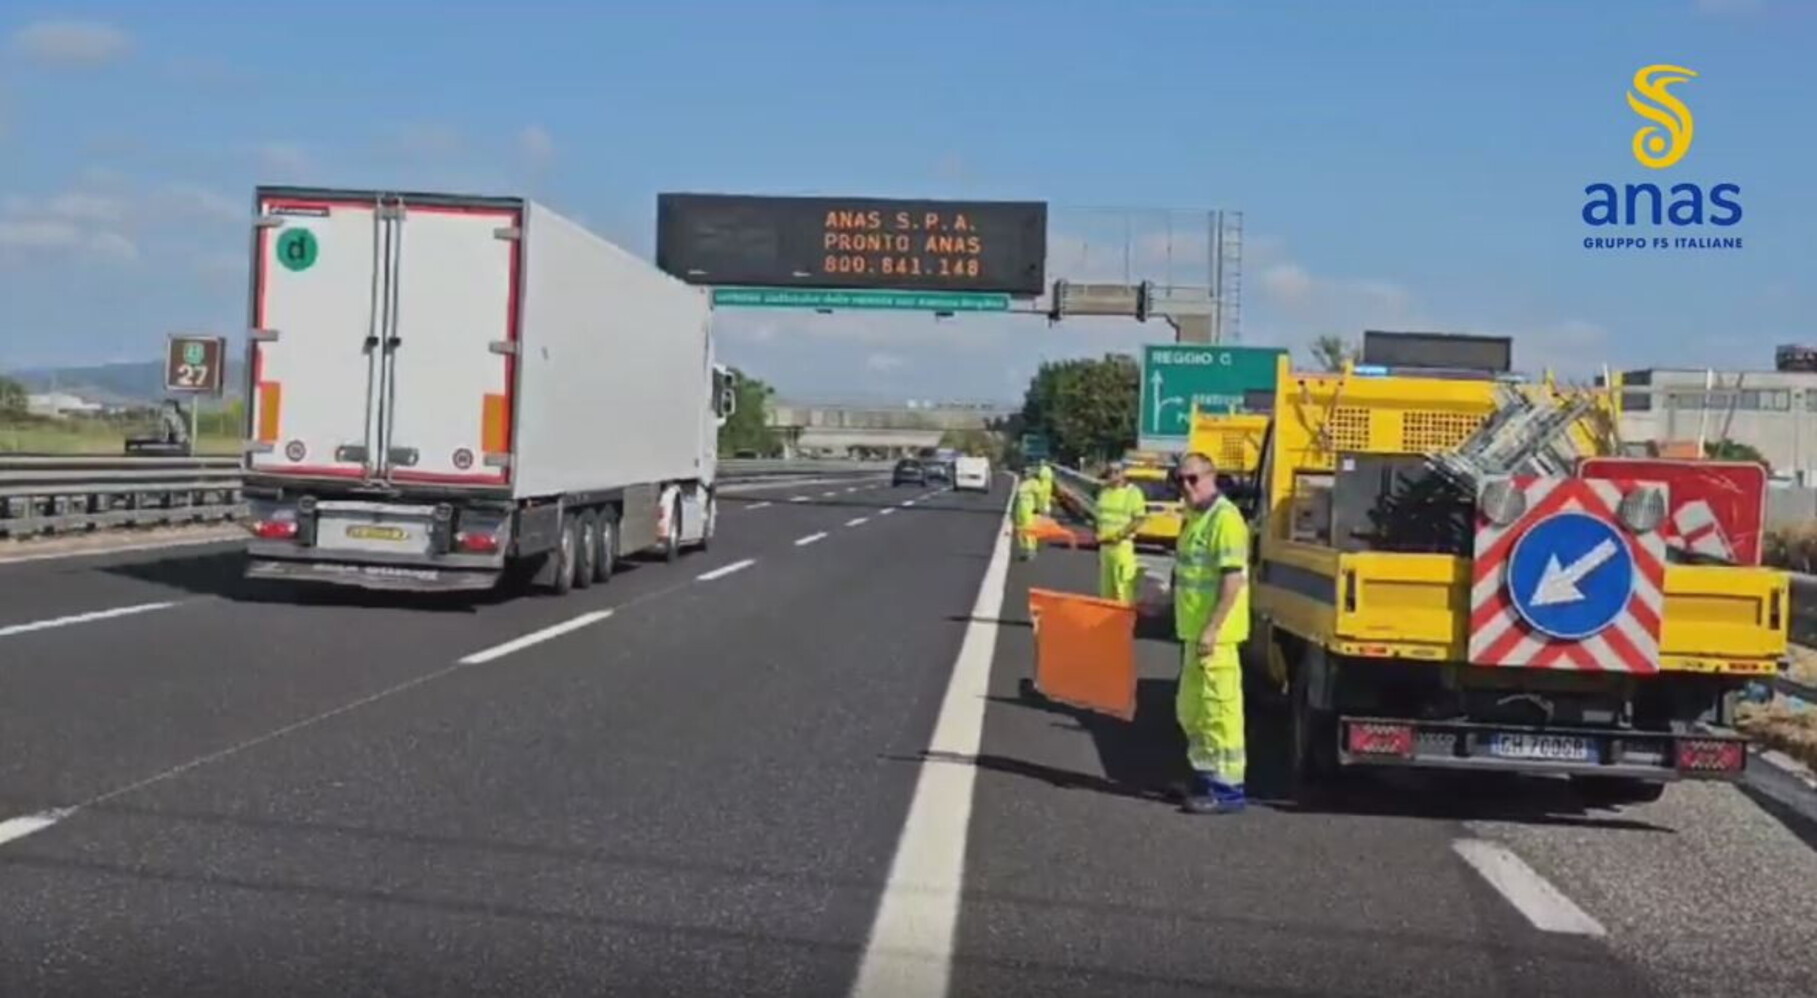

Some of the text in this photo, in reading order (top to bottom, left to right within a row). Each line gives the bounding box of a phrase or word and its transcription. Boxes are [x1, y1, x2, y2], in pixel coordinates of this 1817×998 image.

[825, 211, 976, 231] ANAS S.P.A.
[287, 236, 305, 260] d
[824, 233, 981, 254] PRONTO ANAS
[1152, 352, 1213, 365] REGGIO
[178, 364, 208, 386] 27
